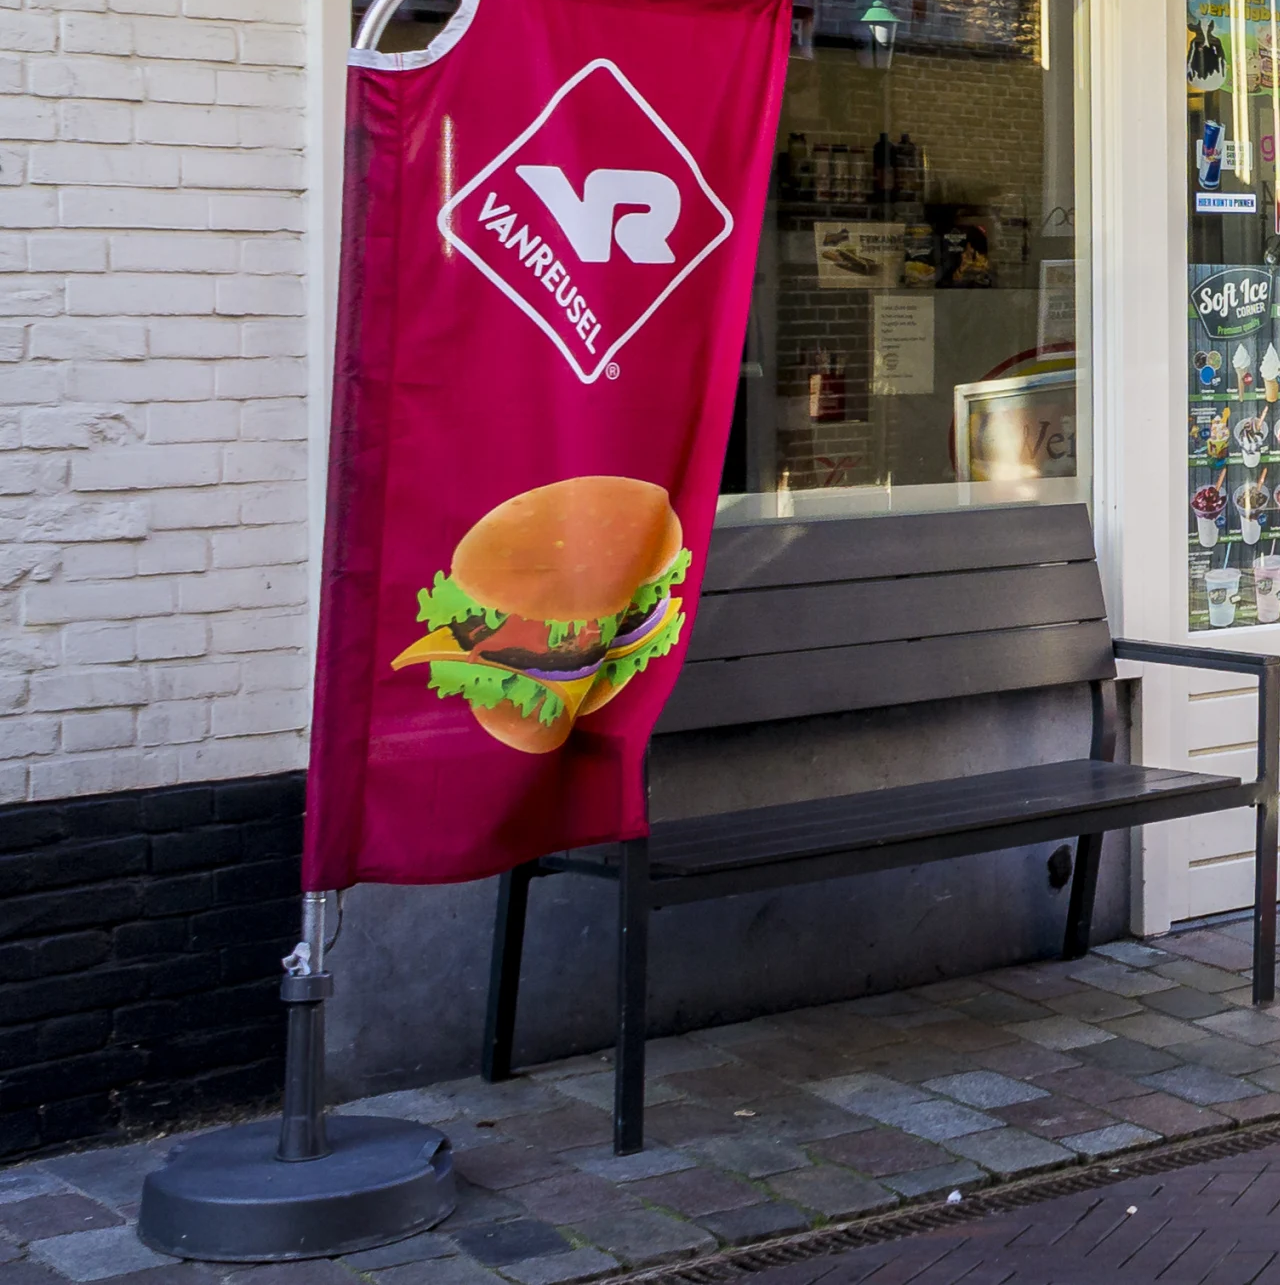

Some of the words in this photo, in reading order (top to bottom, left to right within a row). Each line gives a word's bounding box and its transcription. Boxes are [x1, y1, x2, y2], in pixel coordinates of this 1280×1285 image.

[515, 165, 681, 263] VR
[1234, 199, 1254, 207] PINNEN
[478, 192, 602, 354] VANREUSEL
[1200, 282, 1239, 317] Soft
[1239, 278, 1268, 305] Ice
[1236, 302, 1265, 318] CORNER
[1217, 324, 1243, 335] Premium
